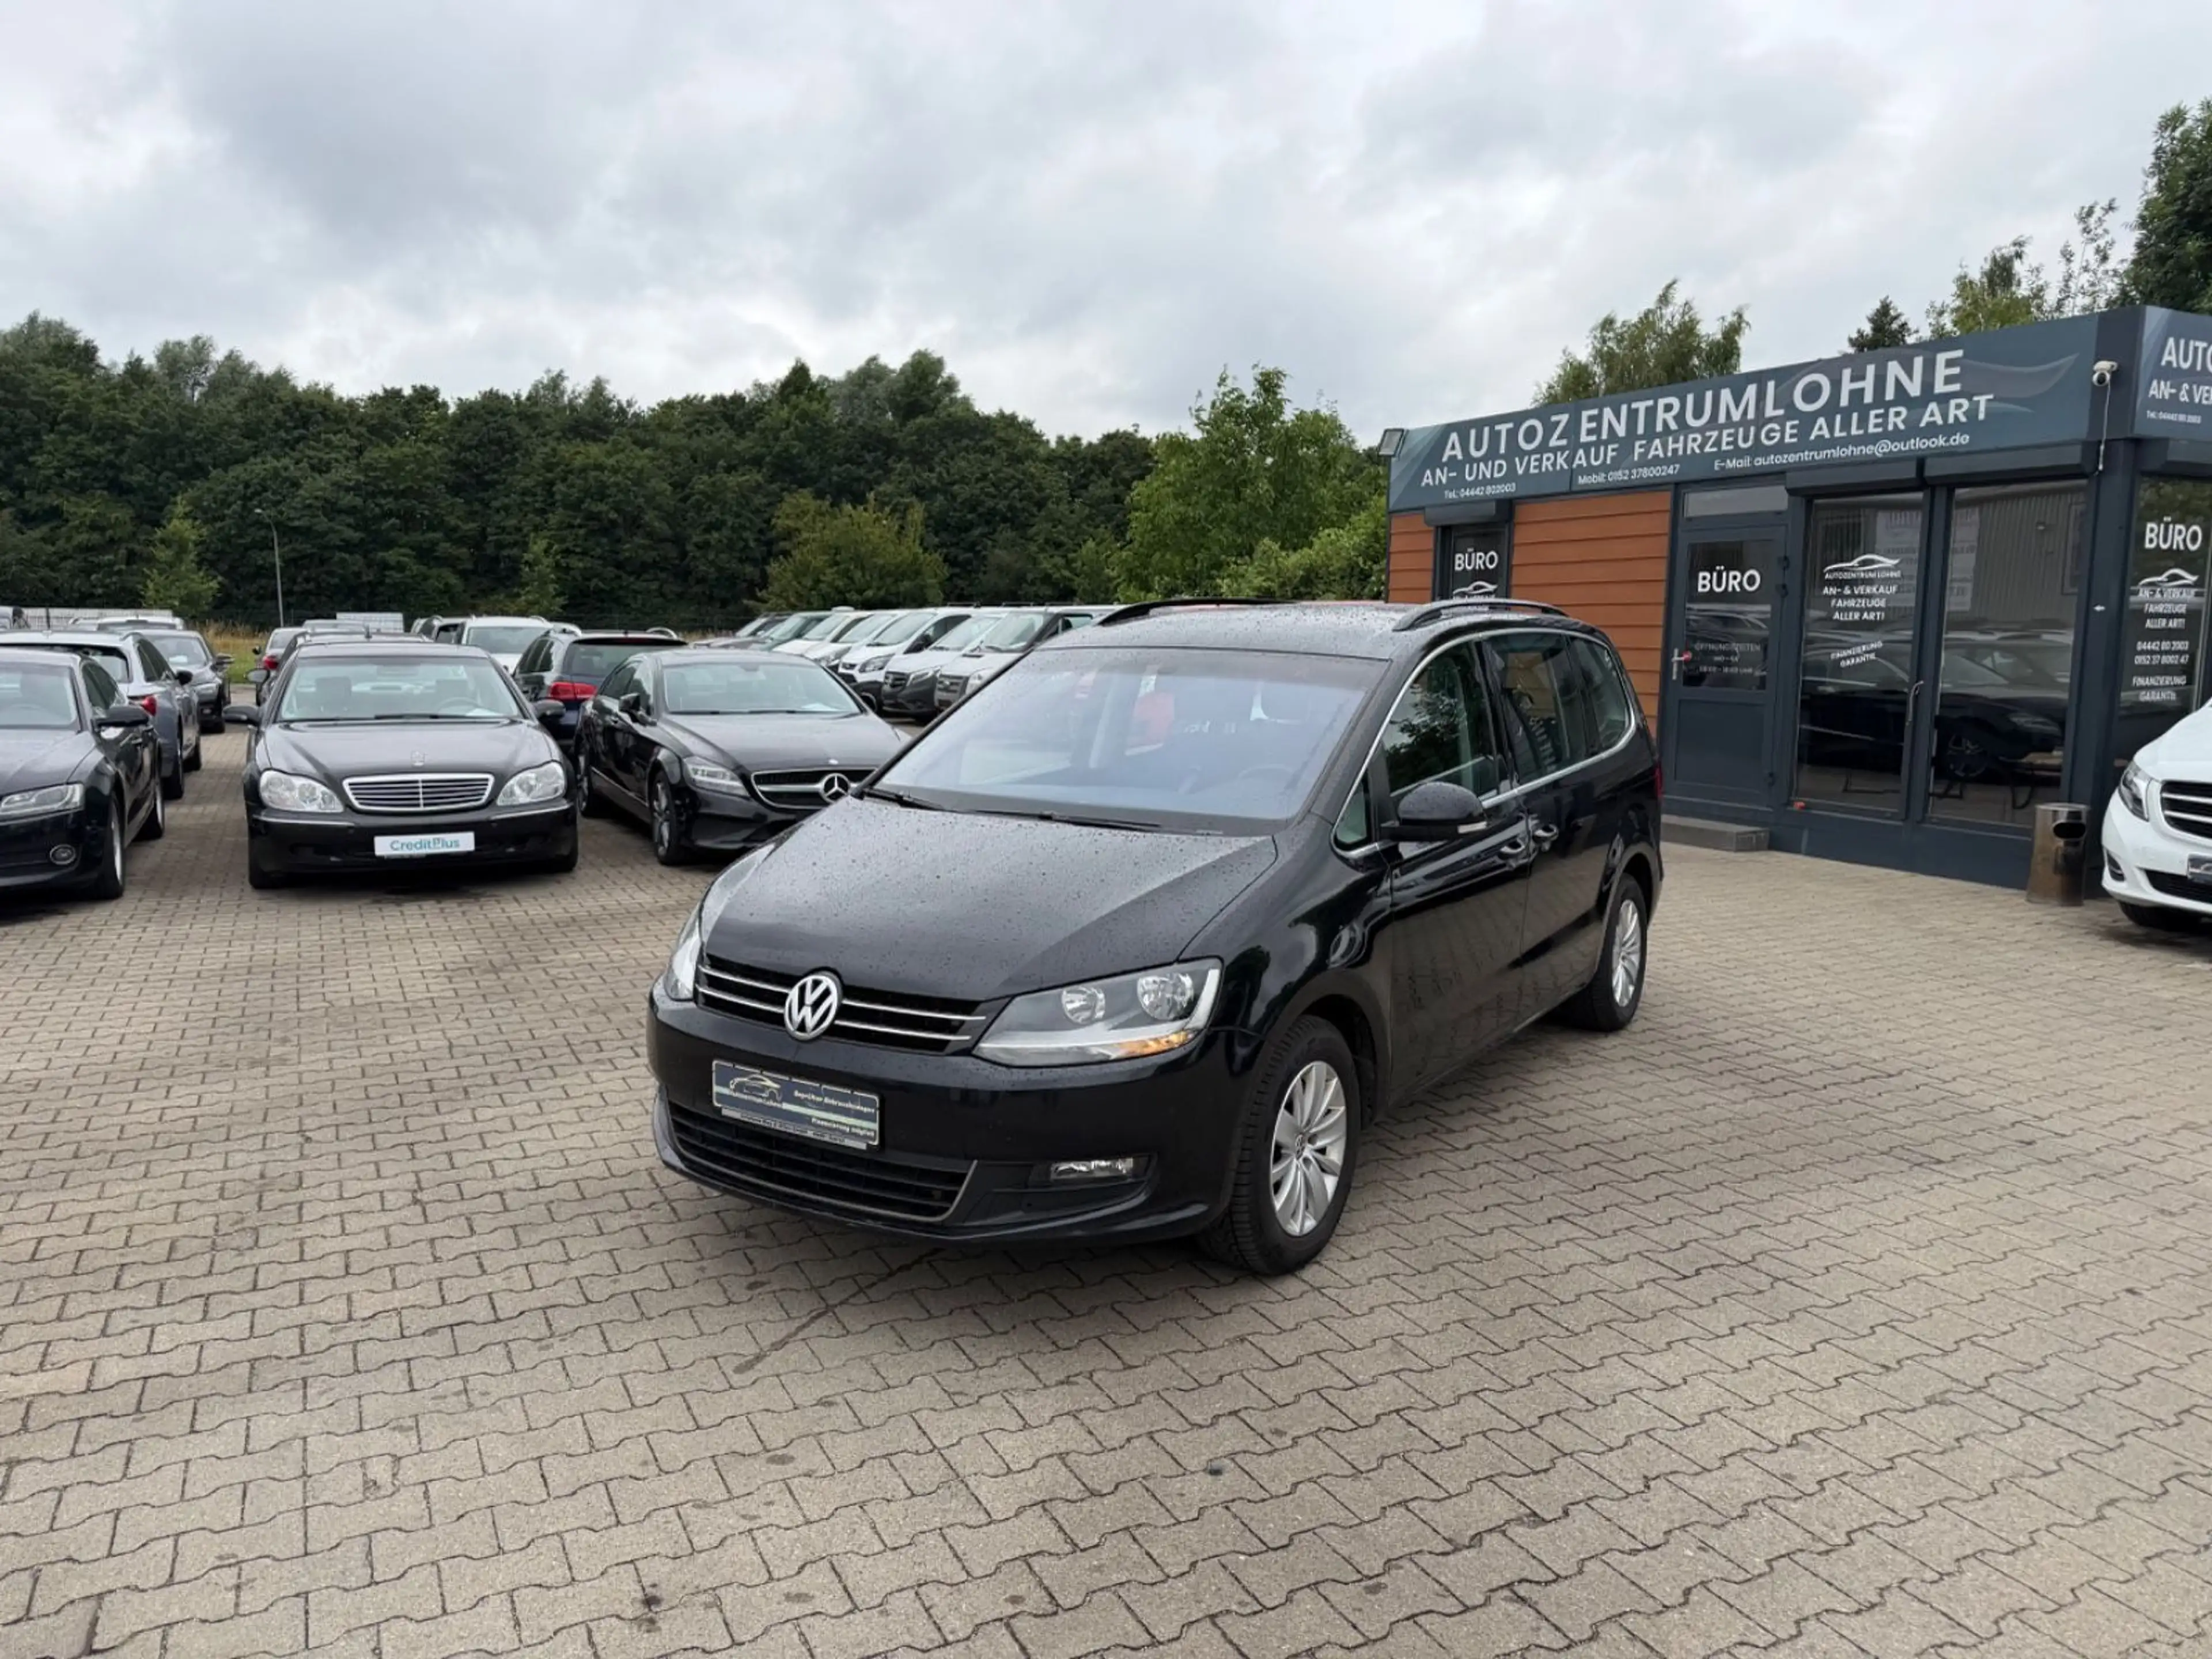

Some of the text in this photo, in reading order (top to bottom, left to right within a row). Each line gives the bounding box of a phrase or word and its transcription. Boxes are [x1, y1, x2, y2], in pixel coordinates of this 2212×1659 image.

[2149, 379, 2212, 405] AN- & VE
[1421, 394, 1994, 487] AN- UND VERKAUF FAHRZEUGE ALLER ART
[2144, 516, 2202, 551] BÜRO
[1455, 548, 1499, 571] BÜRO
[1698, 565, 1761, 593] BÜRO
[1823, 584, 1899, 595] AN- & VERKAUF
[1831, 597, 1887, 608] FAHRZEUGE
[1832, 611, 1861, 621] ALLER
[390, 837, 460, 851] CreditPlus
